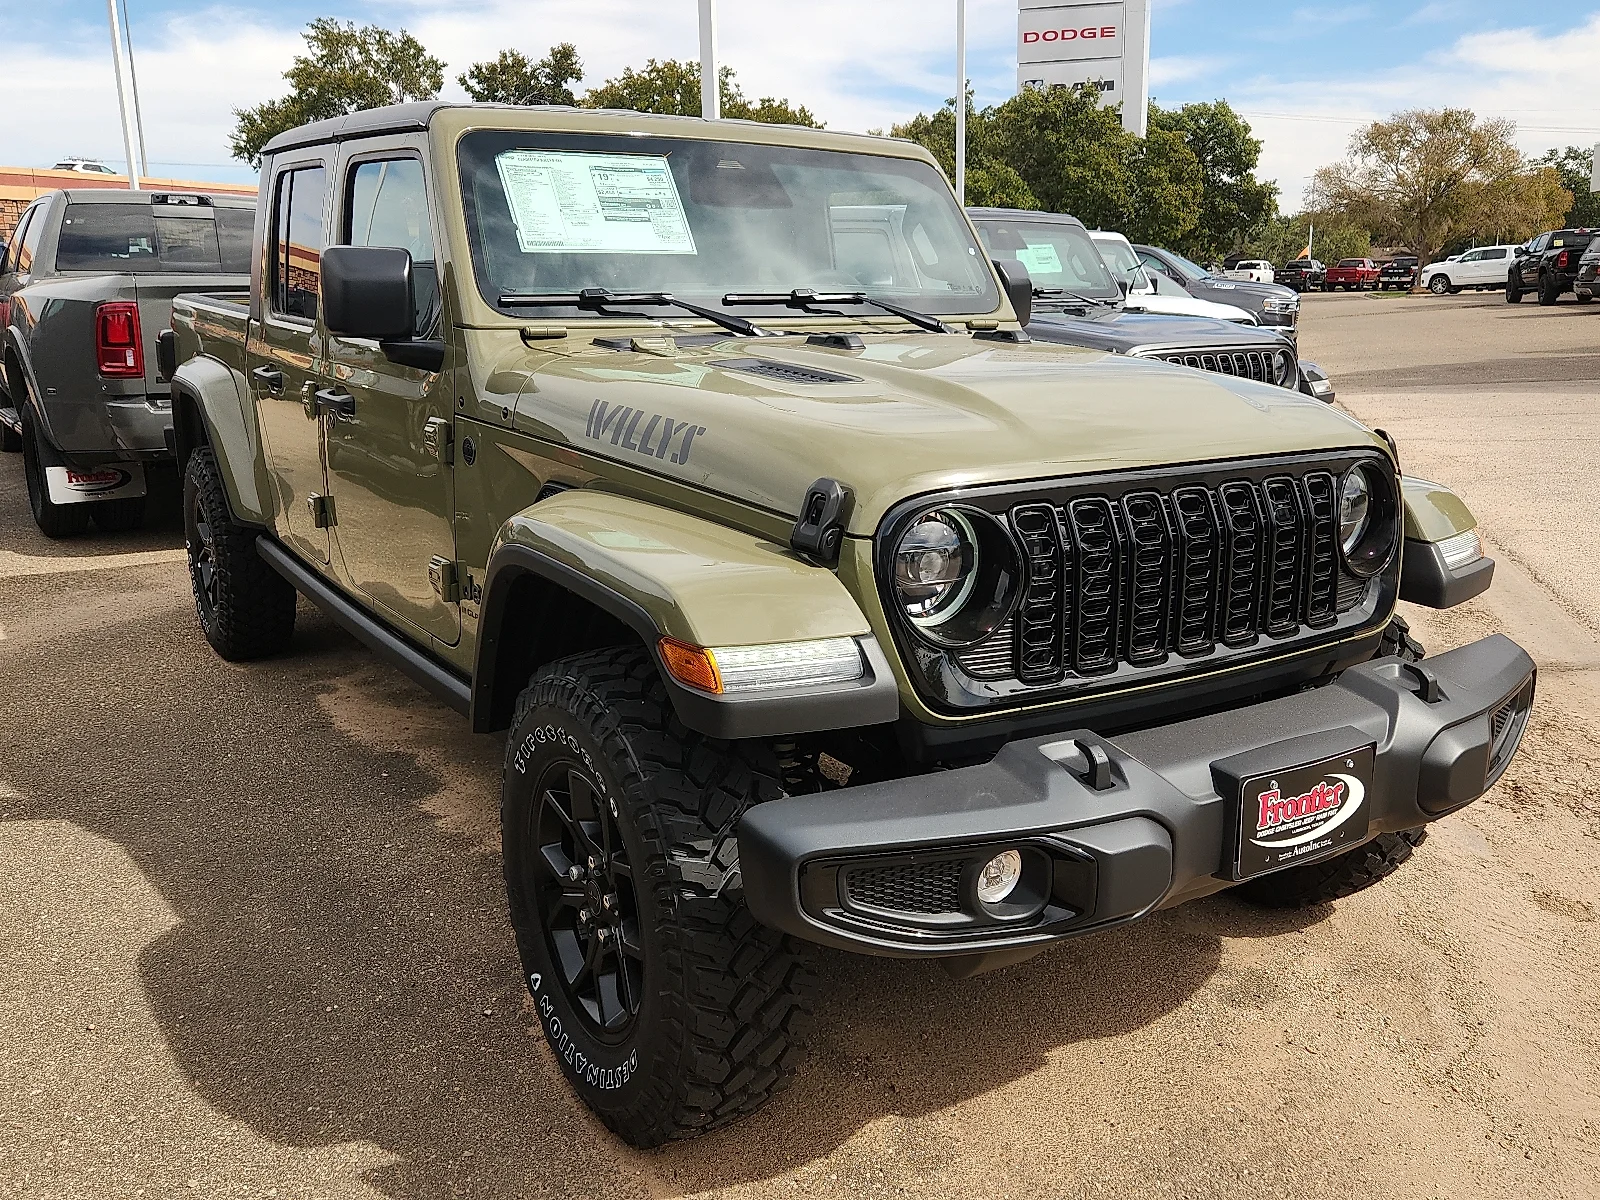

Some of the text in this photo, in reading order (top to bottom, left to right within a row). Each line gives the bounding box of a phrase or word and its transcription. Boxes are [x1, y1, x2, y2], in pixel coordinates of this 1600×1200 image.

[1023, 26, 1116, 44] DODGE
[585, 398, 707, 465] WILLYS
[1256, 781, 1345, 830] Frontier
[540, 994, 638, 1089] DESTINATION
